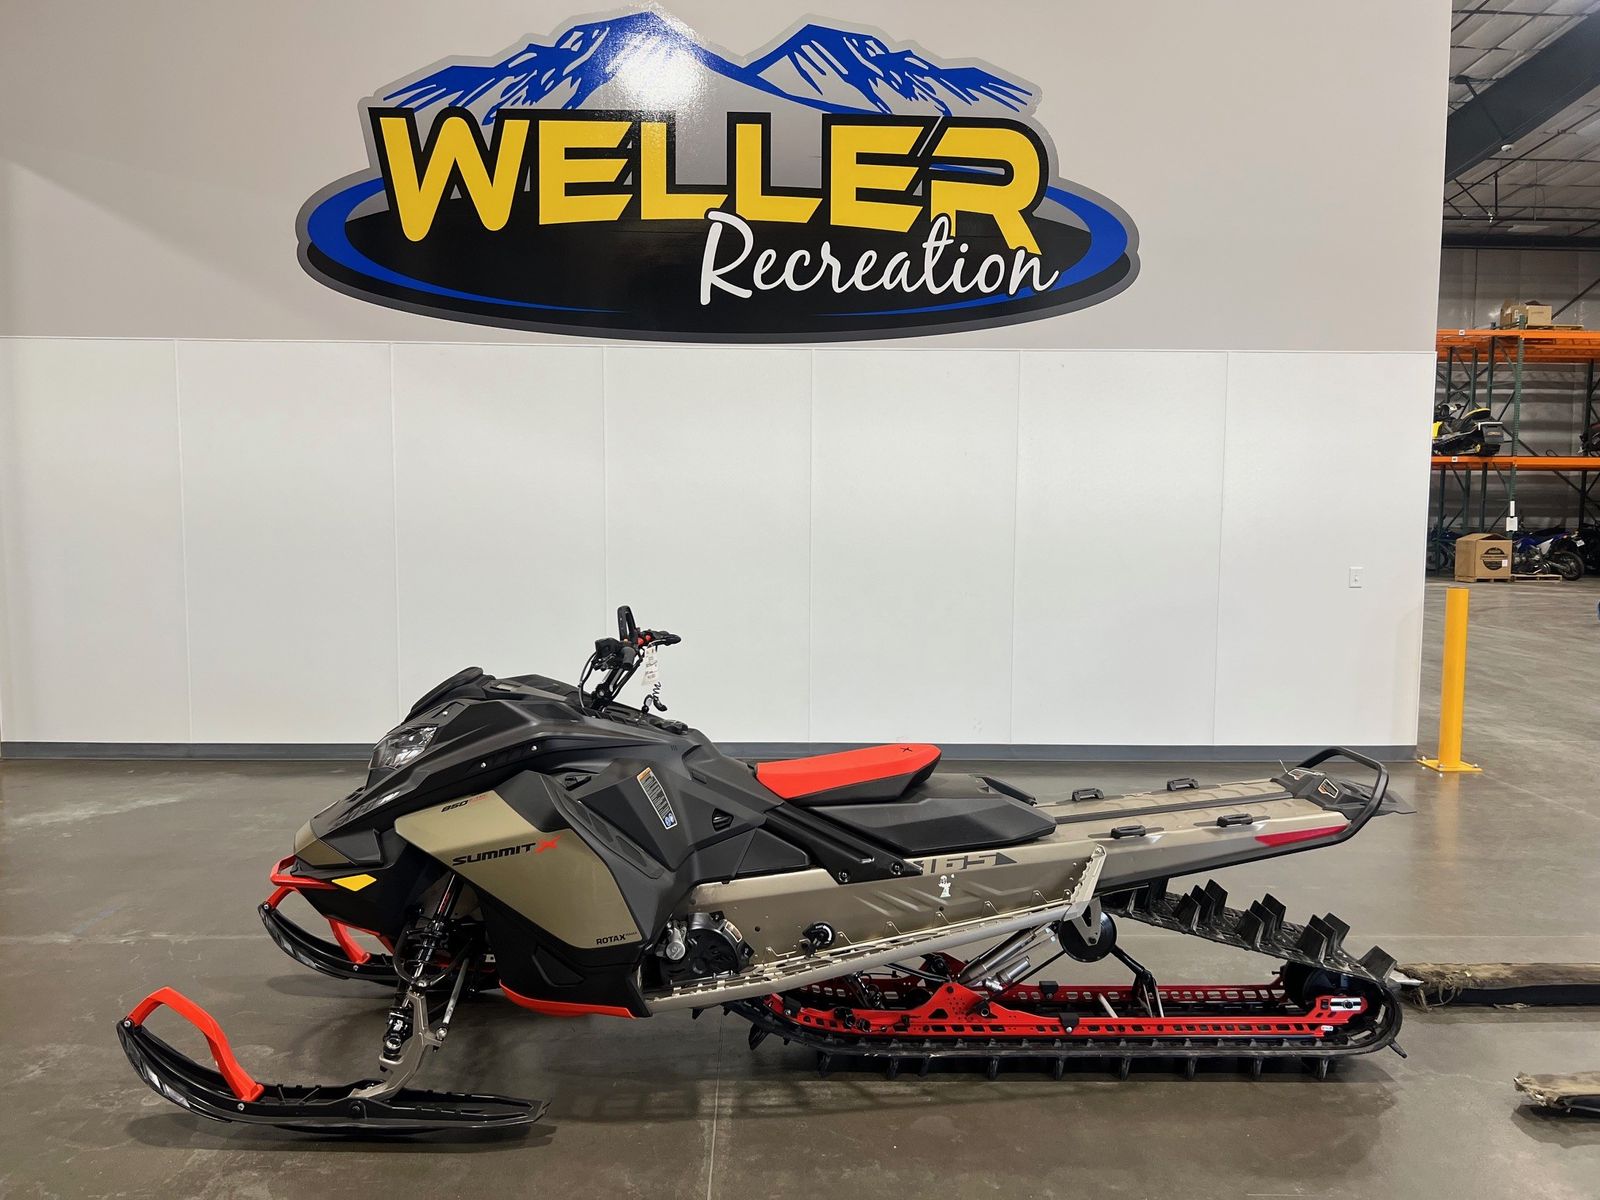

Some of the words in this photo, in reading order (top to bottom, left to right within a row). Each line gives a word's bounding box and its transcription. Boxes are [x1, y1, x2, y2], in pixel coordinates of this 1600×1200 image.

[379, 115, 1043, 255] WELLER
[700, 210, 1059, 306] Recreation
[441, 800, 469, 812] 850
[452, 842, 536, 866] SUMMIT
[595, 933, 626, 945] ROTAX
